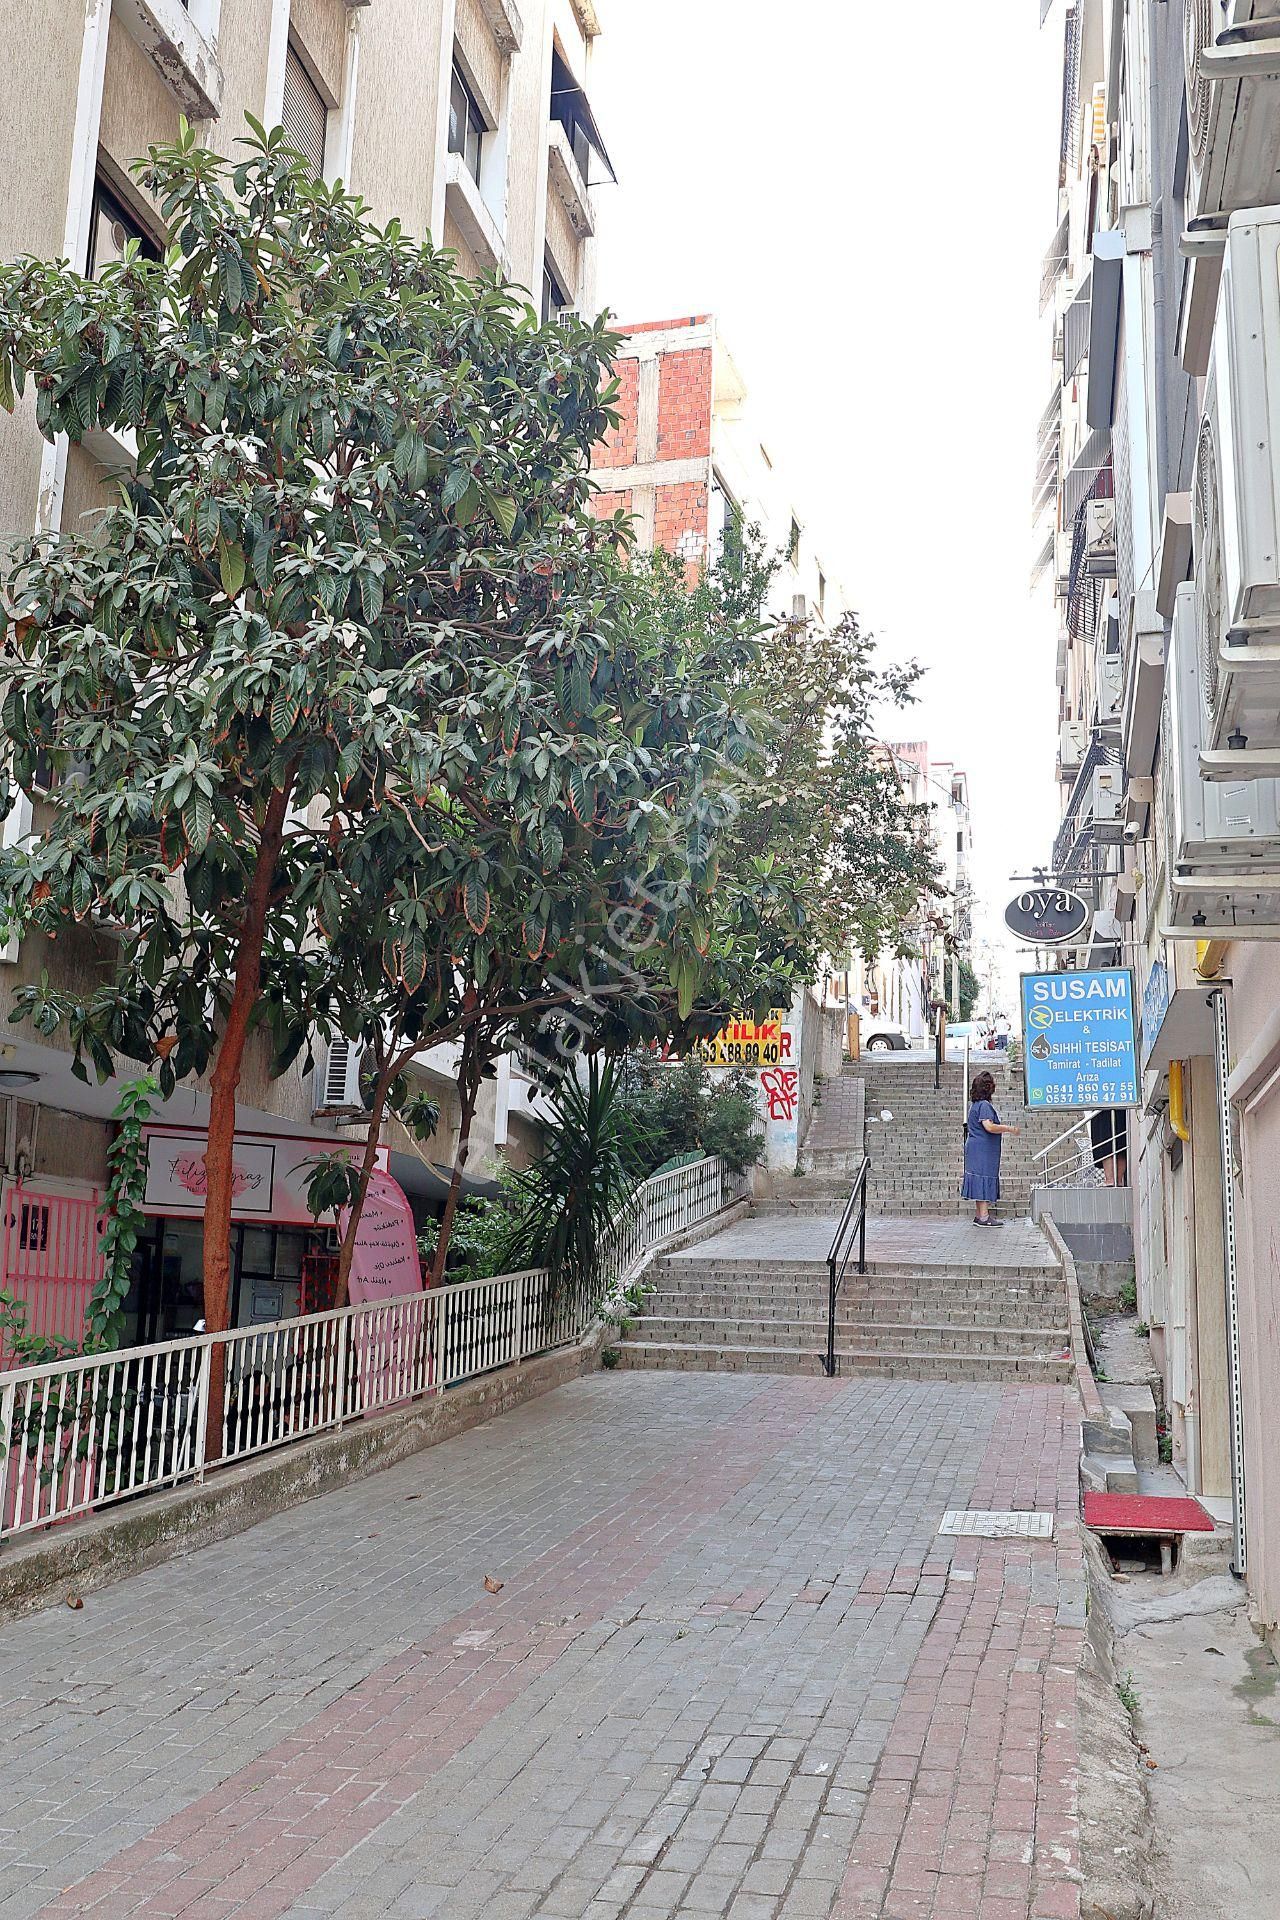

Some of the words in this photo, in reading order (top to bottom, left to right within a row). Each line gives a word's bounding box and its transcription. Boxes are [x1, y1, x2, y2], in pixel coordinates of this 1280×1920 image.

[1017, 892, 1074, 919] oya
[1033, 978, 1126, 1001] SUSAM
[1055, 1006, 1128, 1023] ELEKTRİK
[1082, 1025, 1091, 1034] &
[763, 1043, 778, 1063] 40
[1053, 1041, 1082, 1055] SIHHİ
[1085, 1039, 1132, 1053] TESİSAT
[1047, 1059, 1081, 1070] Tamirat
[1091, 1057, 1121, 1068] Tadilat
[1046, 1084, 1073, 1094] 0541
[1077, 1083, 1098, 1093] 860
[1102, 1082, 1116, 1092] 67
[1120, 1081, 1134, 1091] 55
[1046, 1094, 1073, 1103] 0537
[1078, 1093, 1099, 1102] 596
[1103, 1092, 1116, 1102] 47
[1120, 1091, 1133, 1101] 91
[231, 1171, 264, 1190] yraz
